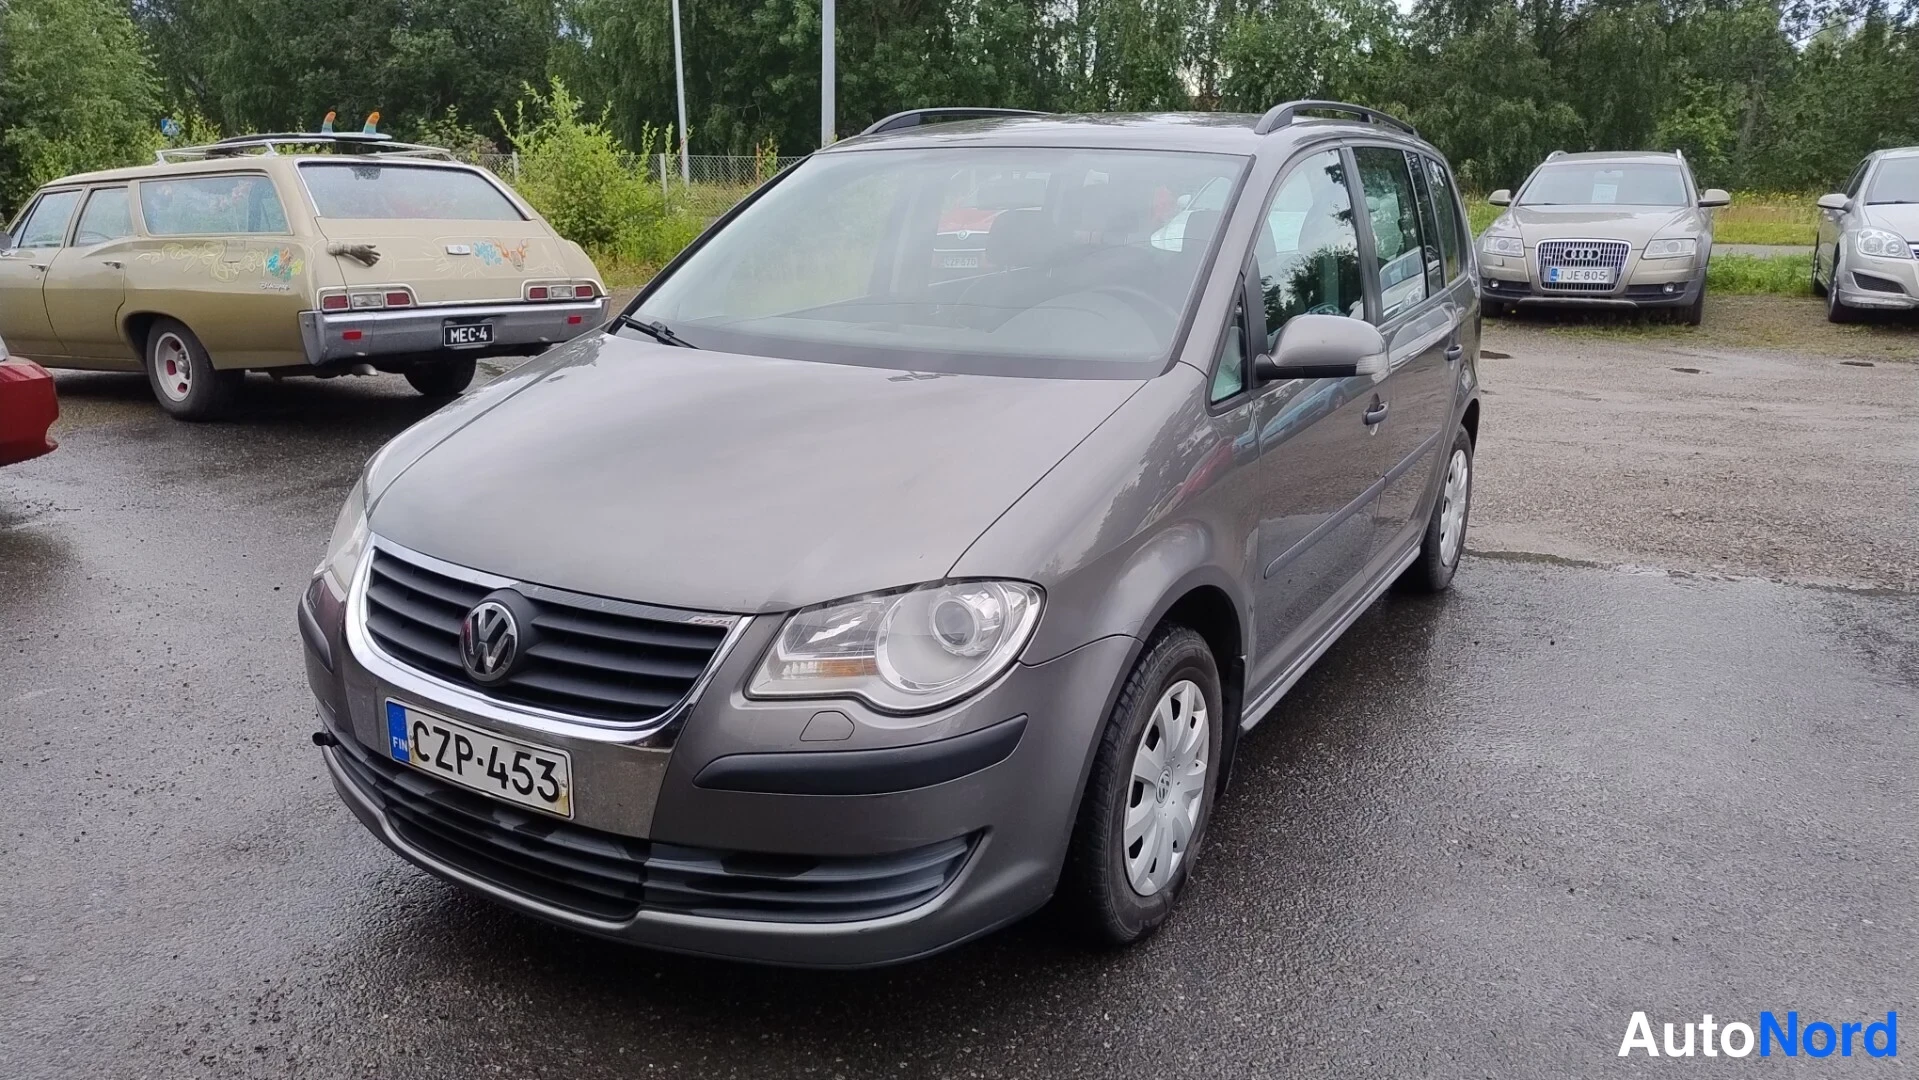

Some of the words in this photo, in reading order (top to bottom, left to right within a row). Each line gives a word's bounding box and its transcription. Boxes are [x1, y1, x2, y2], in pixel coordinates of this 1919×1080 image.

[450, 326, 488, 343] MEC-4
[392, 736, 408, 753] FIN
[412, 720, 560, 803] CZP-453
